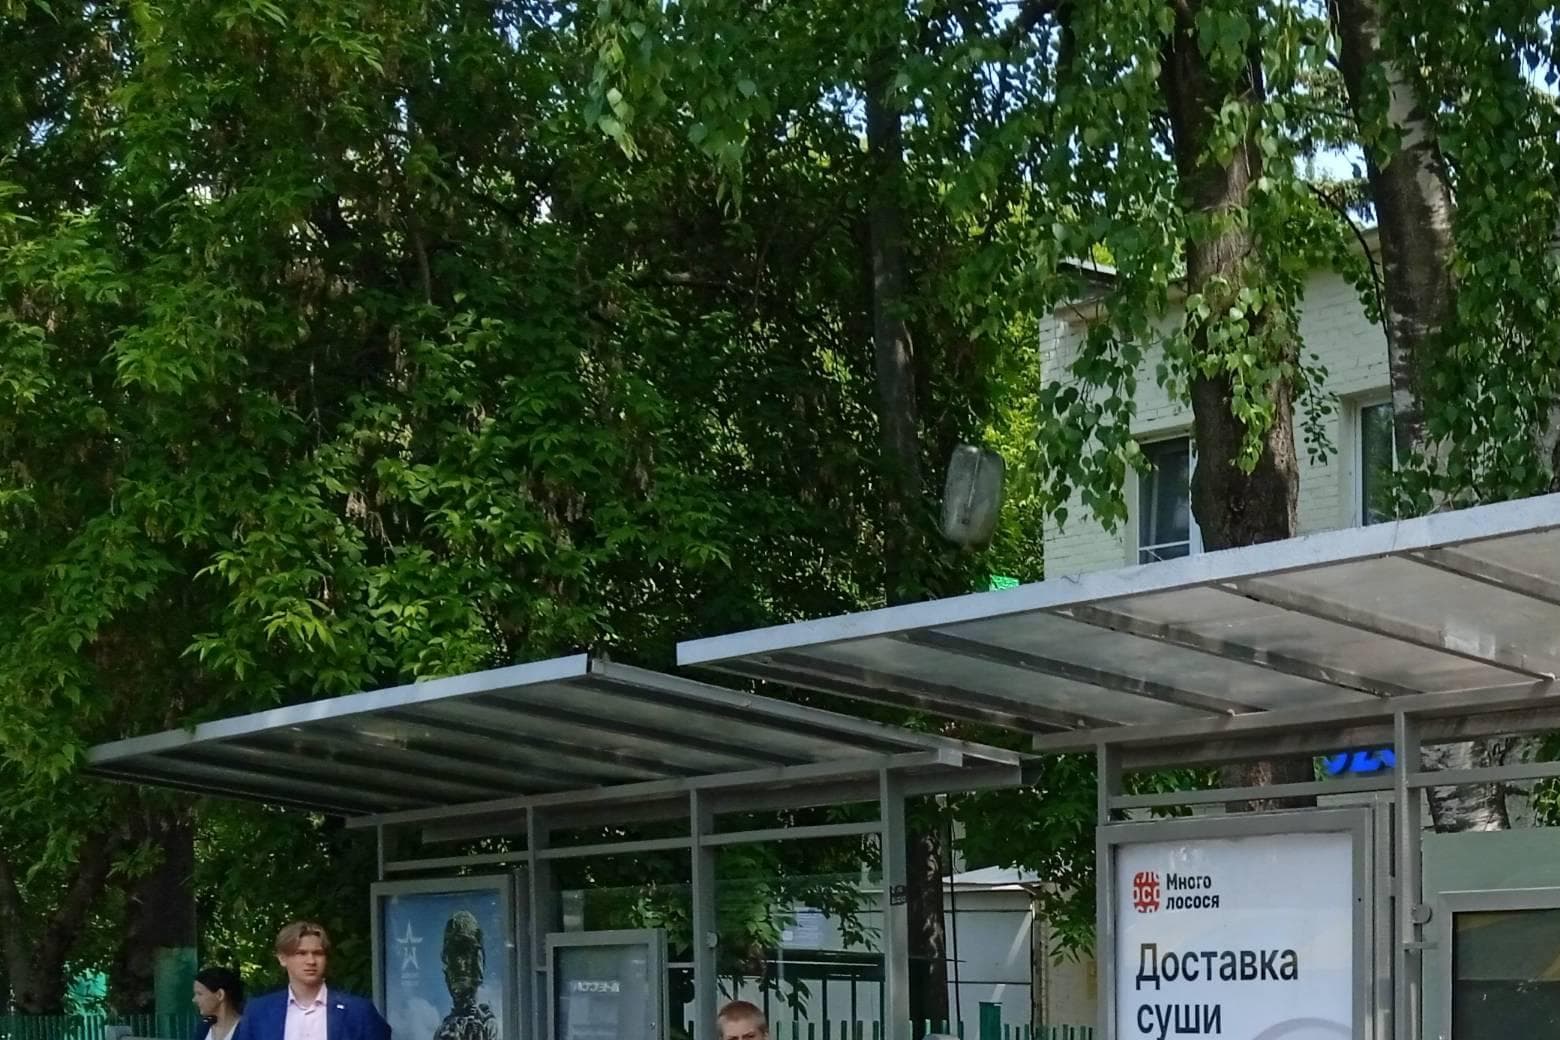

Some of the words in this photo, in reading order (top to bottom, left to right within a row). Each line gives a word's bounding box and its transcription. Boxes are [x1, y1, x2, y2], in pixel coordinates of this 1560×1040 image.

[1166, 873, 1212, 890] Много
[1166, 895, 1220, 911] лосося
[1135, 942, 1299, 991] Доставка
